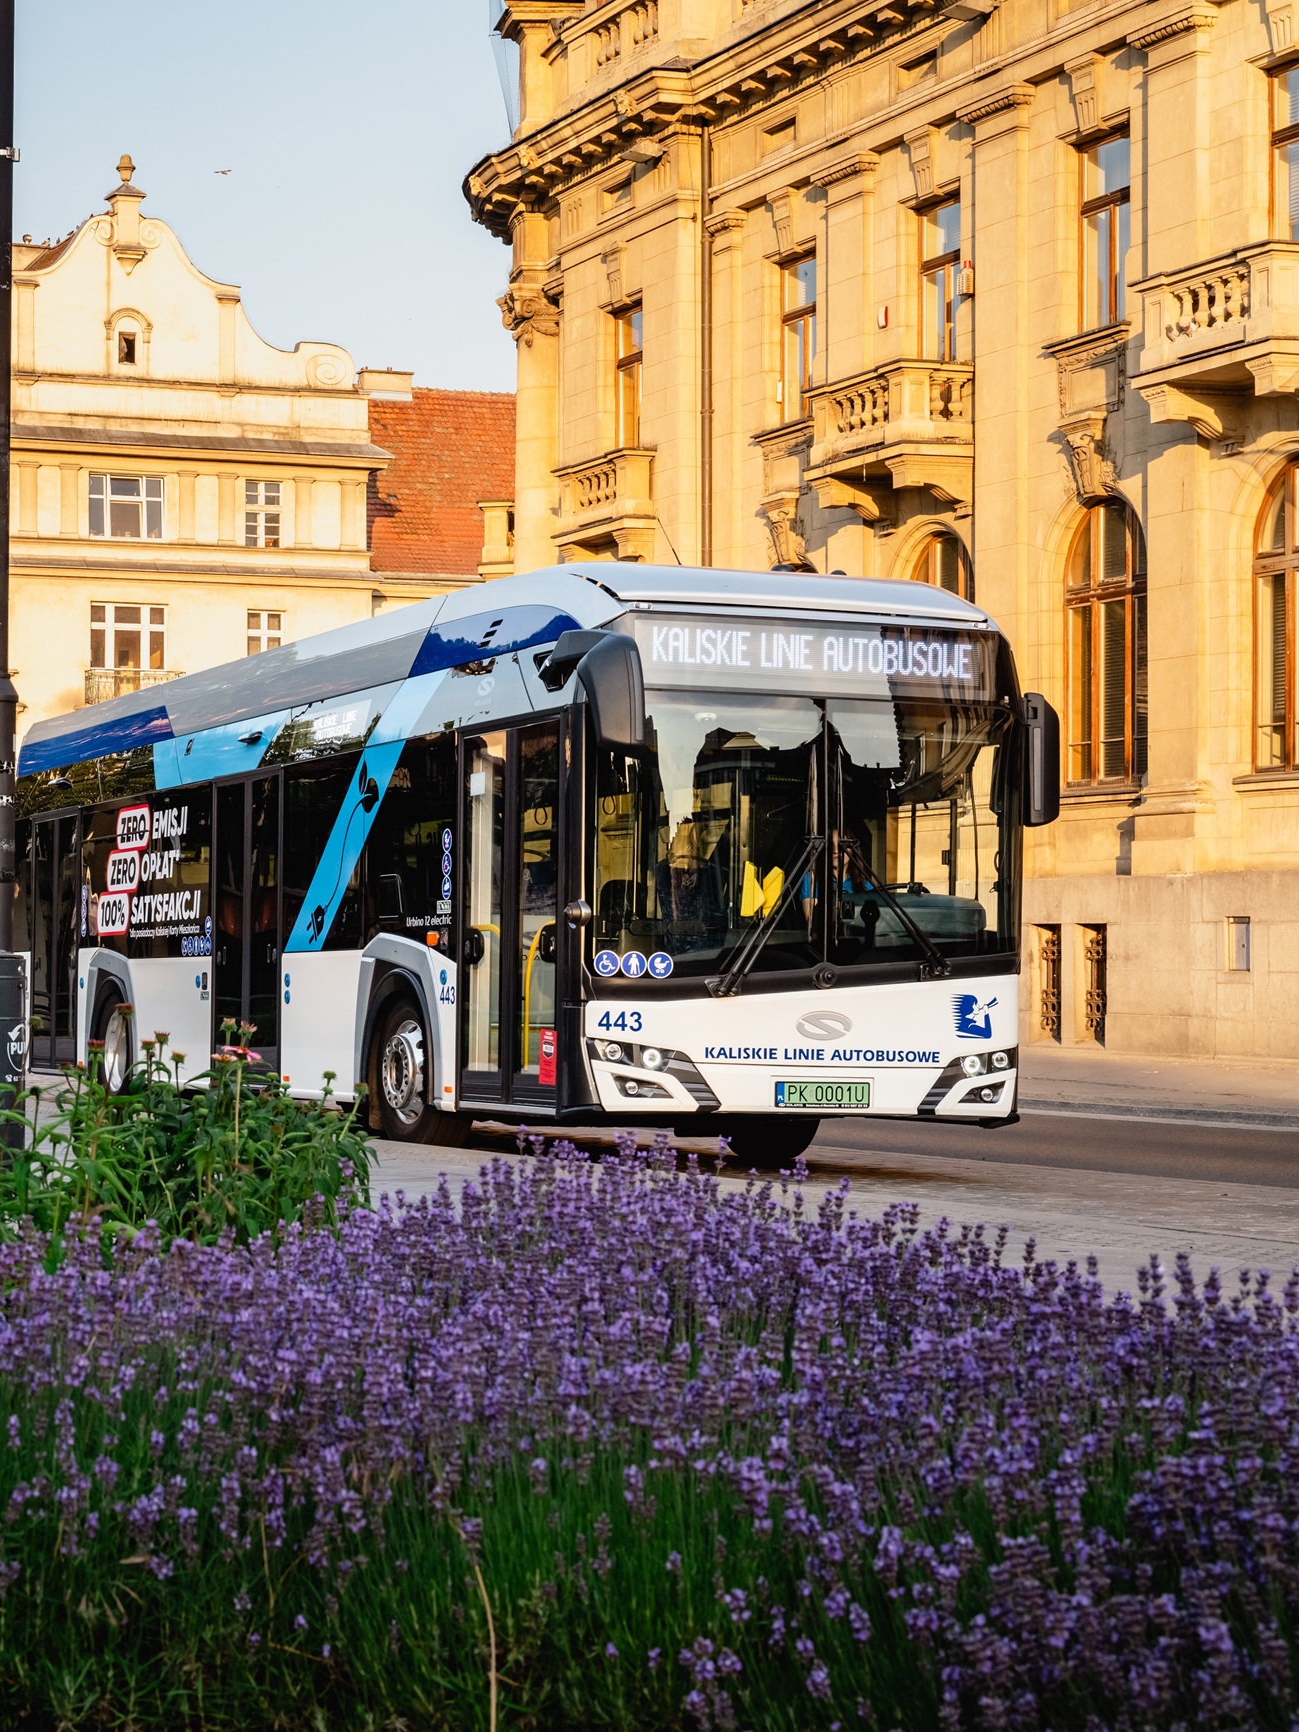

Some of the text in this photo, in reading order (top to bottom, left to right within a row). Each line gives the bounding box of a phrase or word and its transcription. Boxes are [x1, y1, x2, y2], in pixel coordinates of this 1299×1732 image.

[652, 626, 973, 679] KALISKIE LINIE AUTOBUSOWE
[120, 806, 188, 843] ZERO EMISJI
[110, 857, 136, 885] ZERO
[101, 890, 201, 927] 100% SATYSFAKCJI
[406, 914, 452, 927] Urbino 12 electric
[440, 985, 455, 1004] 443
[598, 1010, 643, 1032] 443
[704, 1046, 940, 1064] KALISKIE LINIE AUTOBUSOWE
[788, 1085, 864, 1102] PK 0001U
